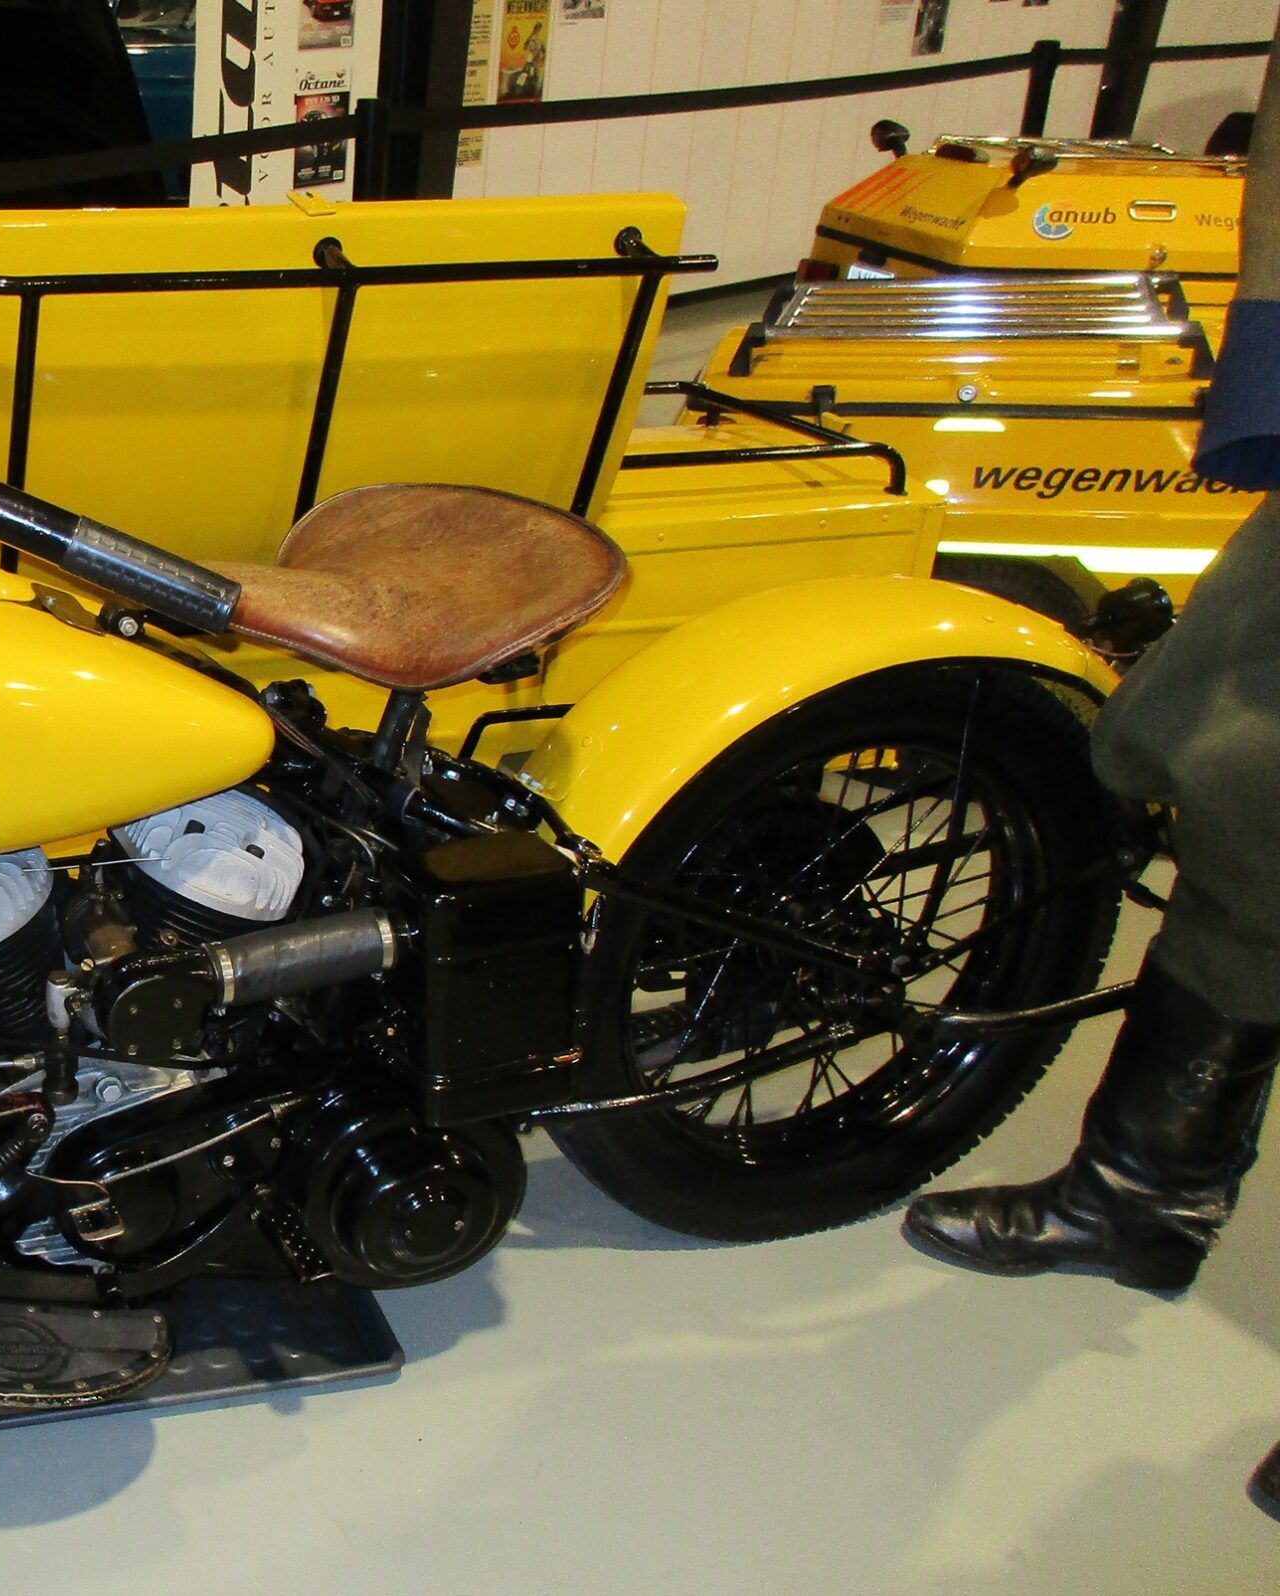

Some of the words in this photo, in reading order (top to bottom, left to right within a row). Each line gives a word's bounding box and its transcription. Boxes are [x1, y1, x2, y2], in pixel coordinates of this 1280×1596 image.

[298, 78, 347, 92] Octane
[900, 205, 967, 231] Wegenwacht
[1049, 207, 1116, 224] anwb
[972, 466, 1256, 499] wegenwac
